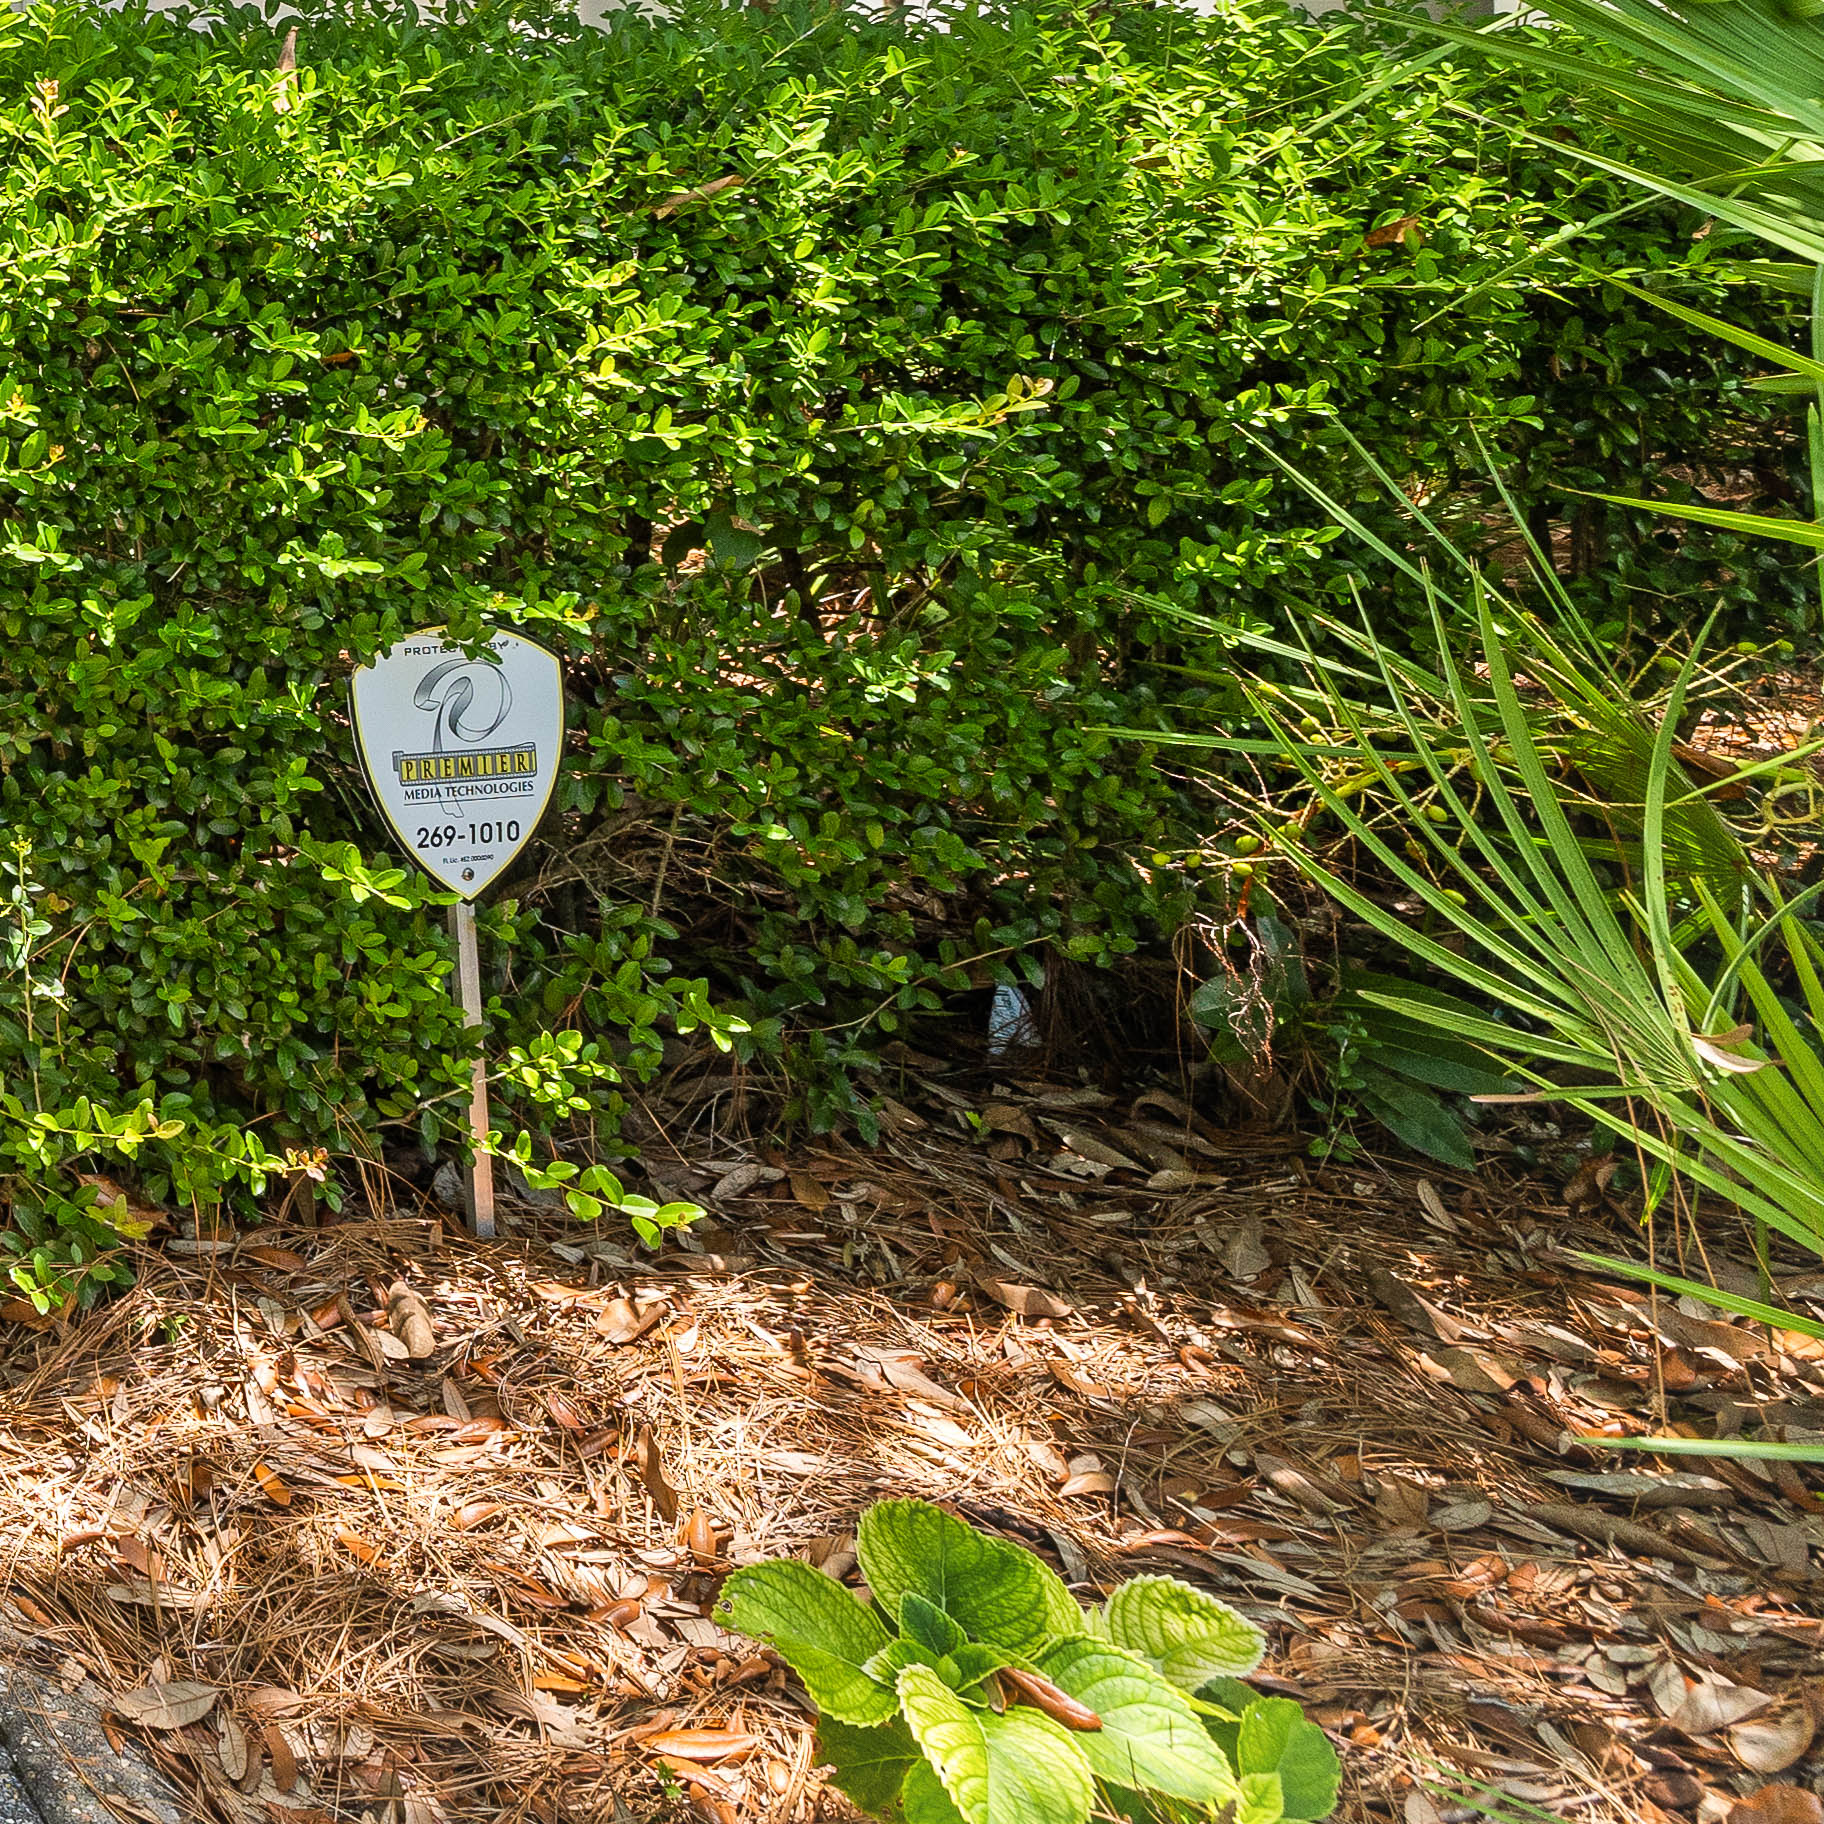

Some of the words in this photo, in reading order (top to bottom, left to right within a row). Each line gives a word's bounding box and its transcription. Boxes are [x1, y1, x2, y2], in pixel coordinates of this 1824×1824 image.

[405, 753, 528, 780] PREMIER
[404, 787, 441, 800] MEDIA
[445, 781, 534, 797] TECHNOLOGIES
[416, 820, 520, 849] 269-1010
